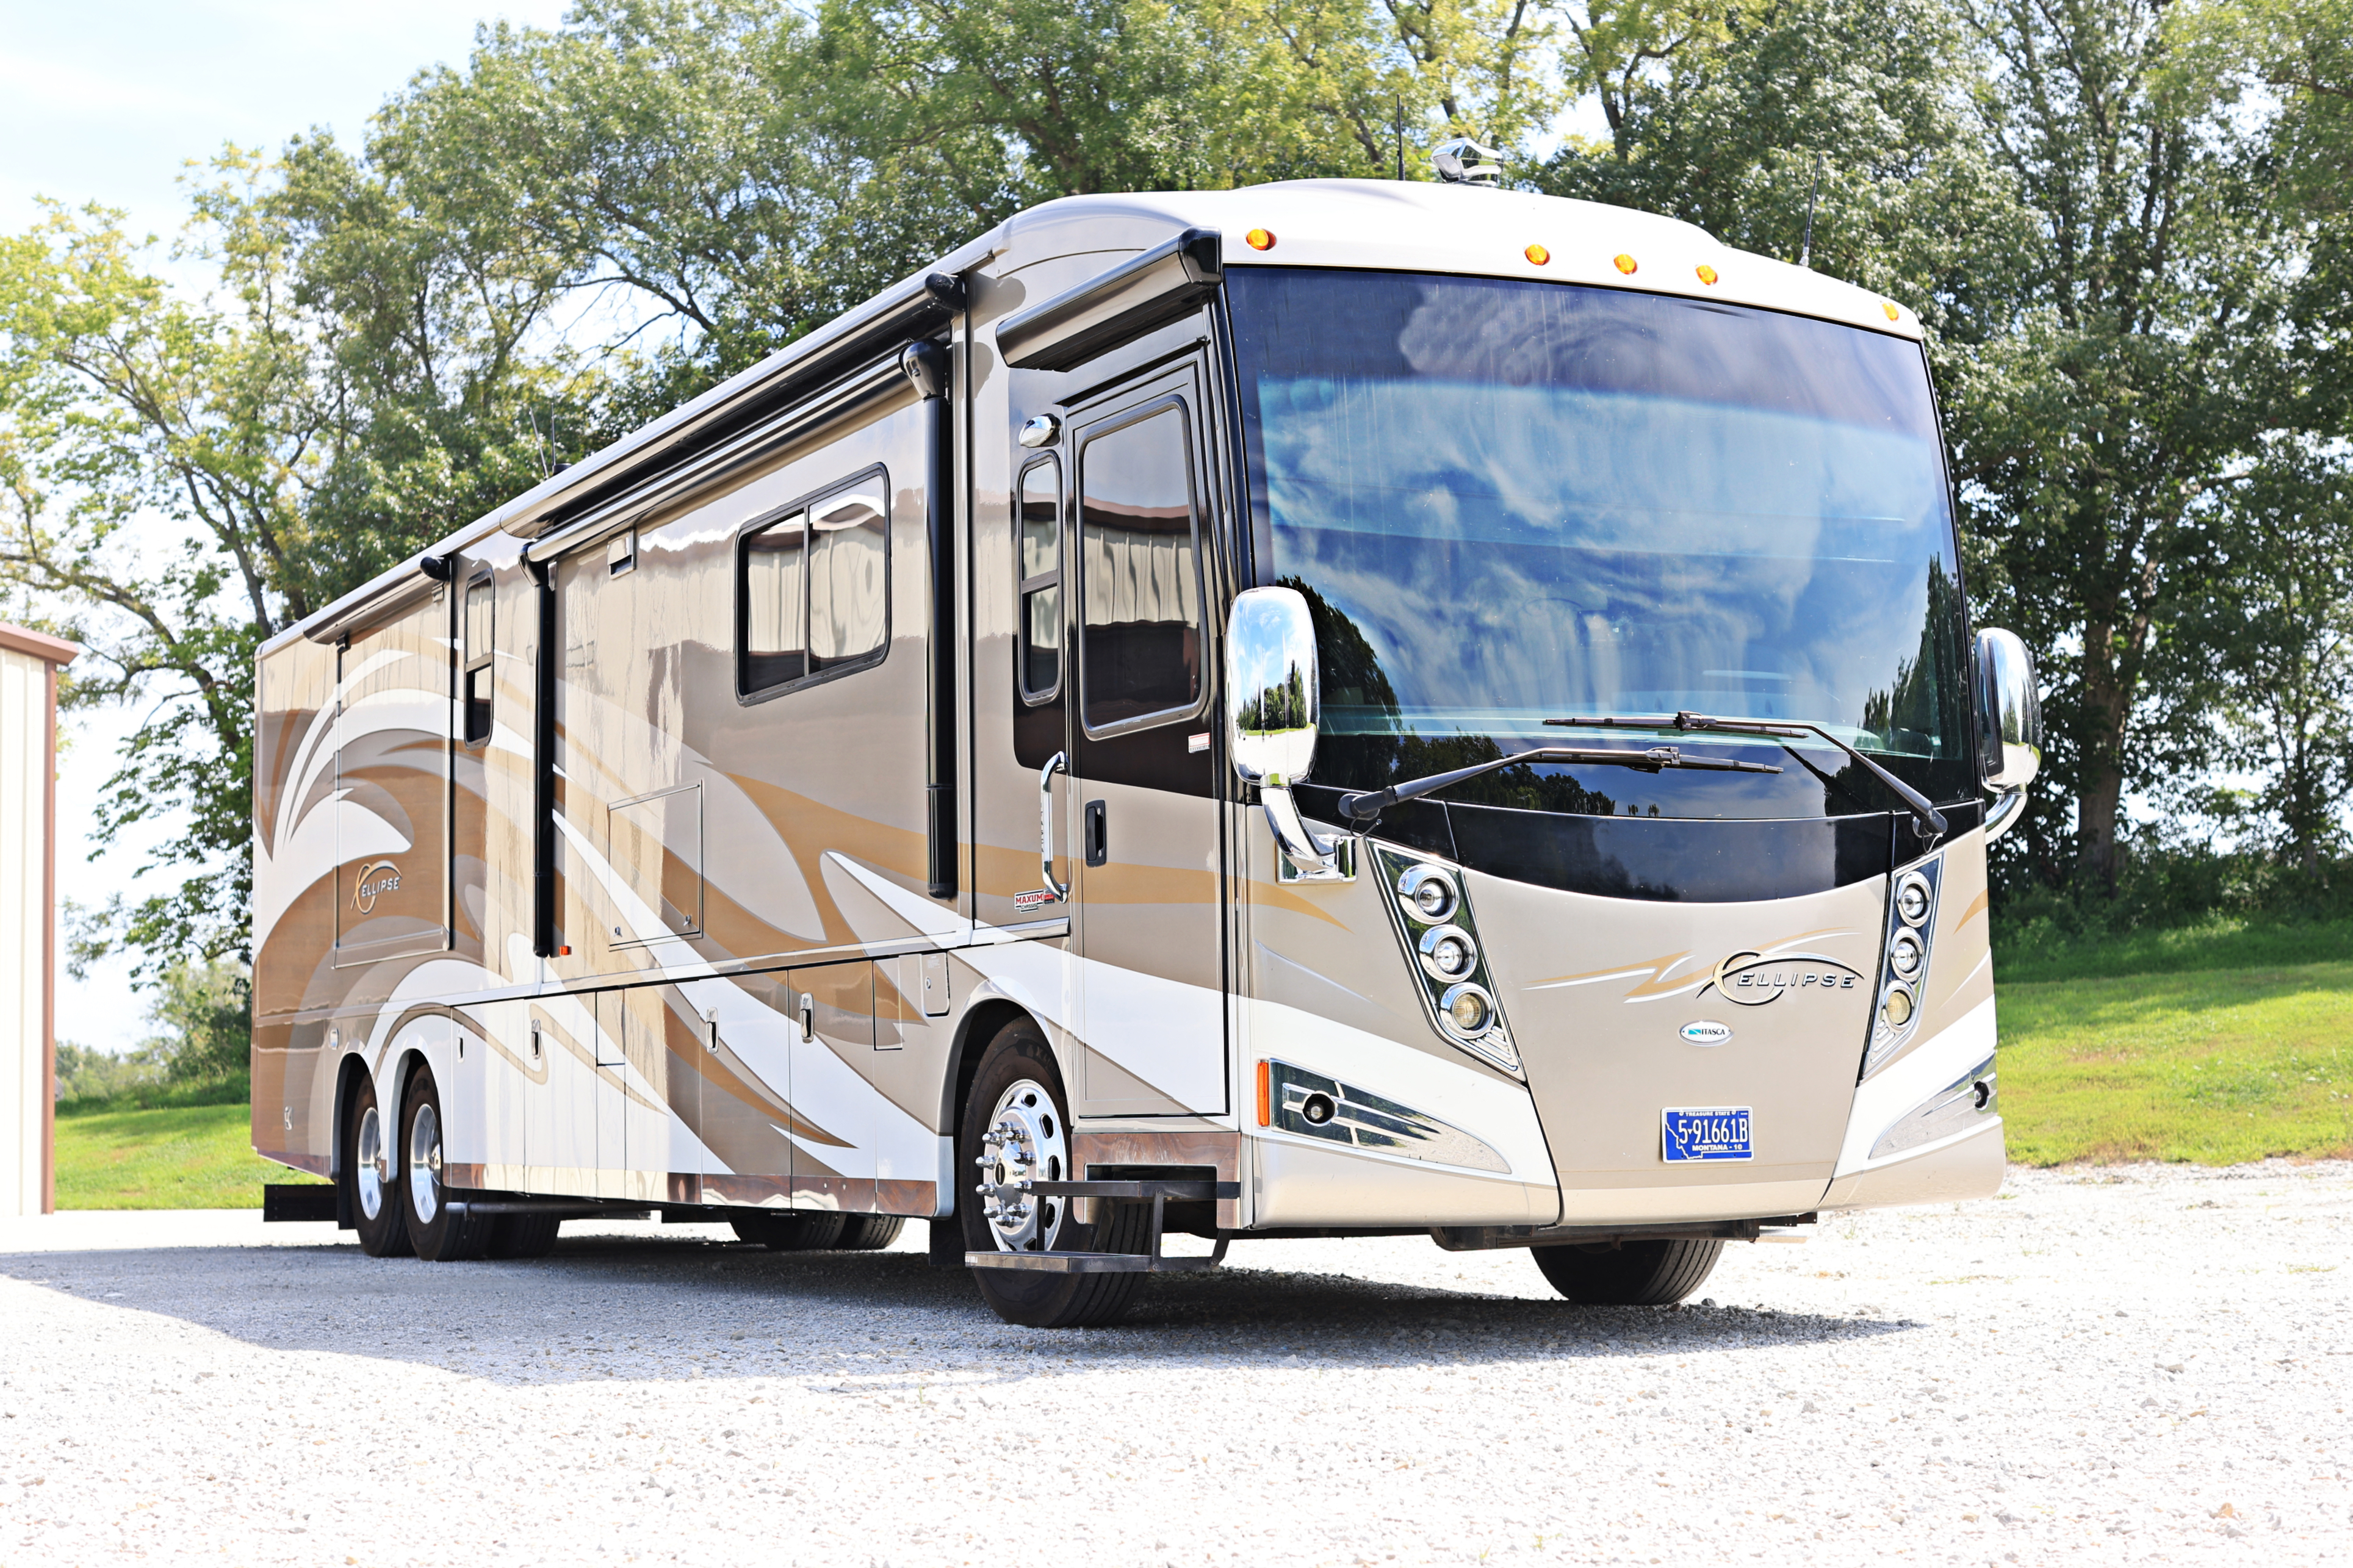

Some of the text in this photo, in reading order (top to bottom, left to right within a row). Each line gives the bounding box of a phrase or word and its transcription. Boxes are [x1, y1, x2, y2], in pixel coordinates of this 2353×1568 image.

[362, 876, 400, 897] ELLIPSE
[1015, 893, 1043, 905] MAXUM
[1737, 972, 1856, 988] ELLIPSE
